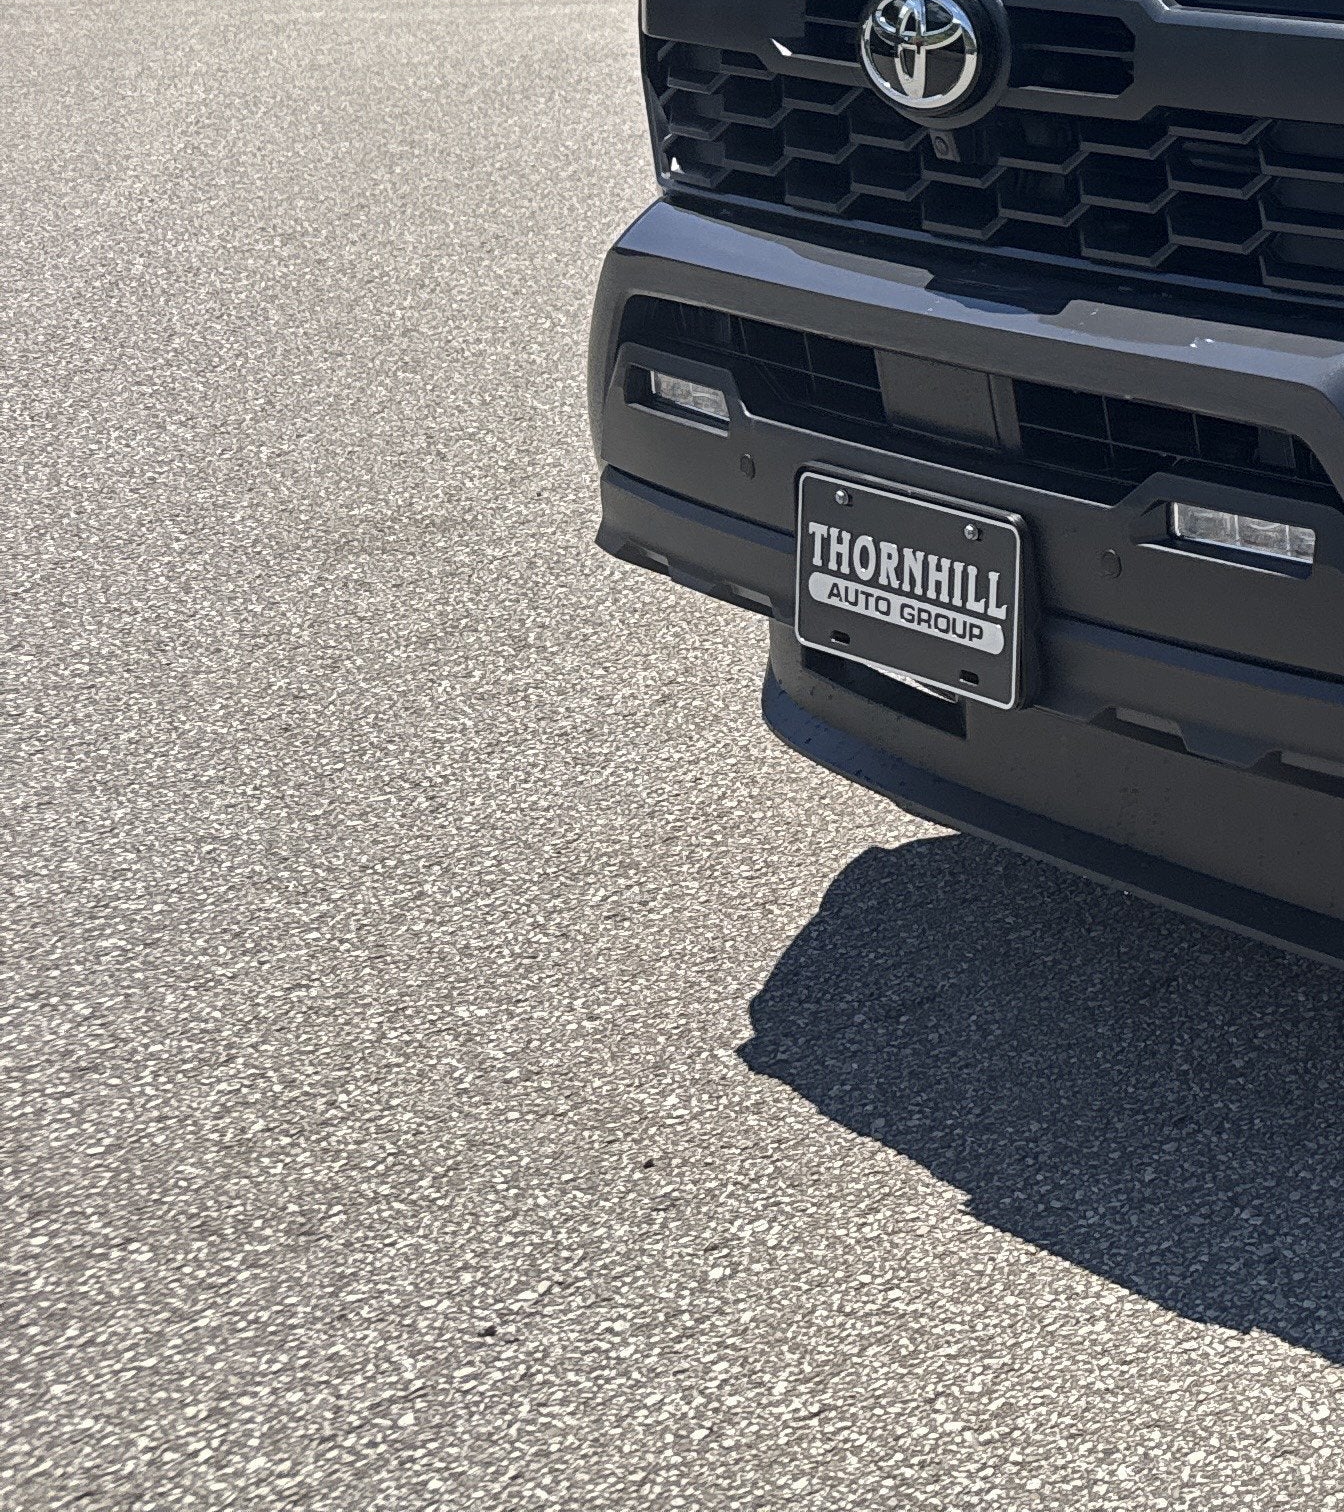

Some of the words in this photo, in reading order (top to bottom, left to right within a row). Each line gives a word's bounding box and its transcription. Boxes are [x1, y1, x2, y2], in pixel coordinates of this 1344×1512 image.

[808, 522, 1007, 620] THORNHILL
[827, 582, 891, 616] AUTO
[900, 603, 983, 641] GROUP
